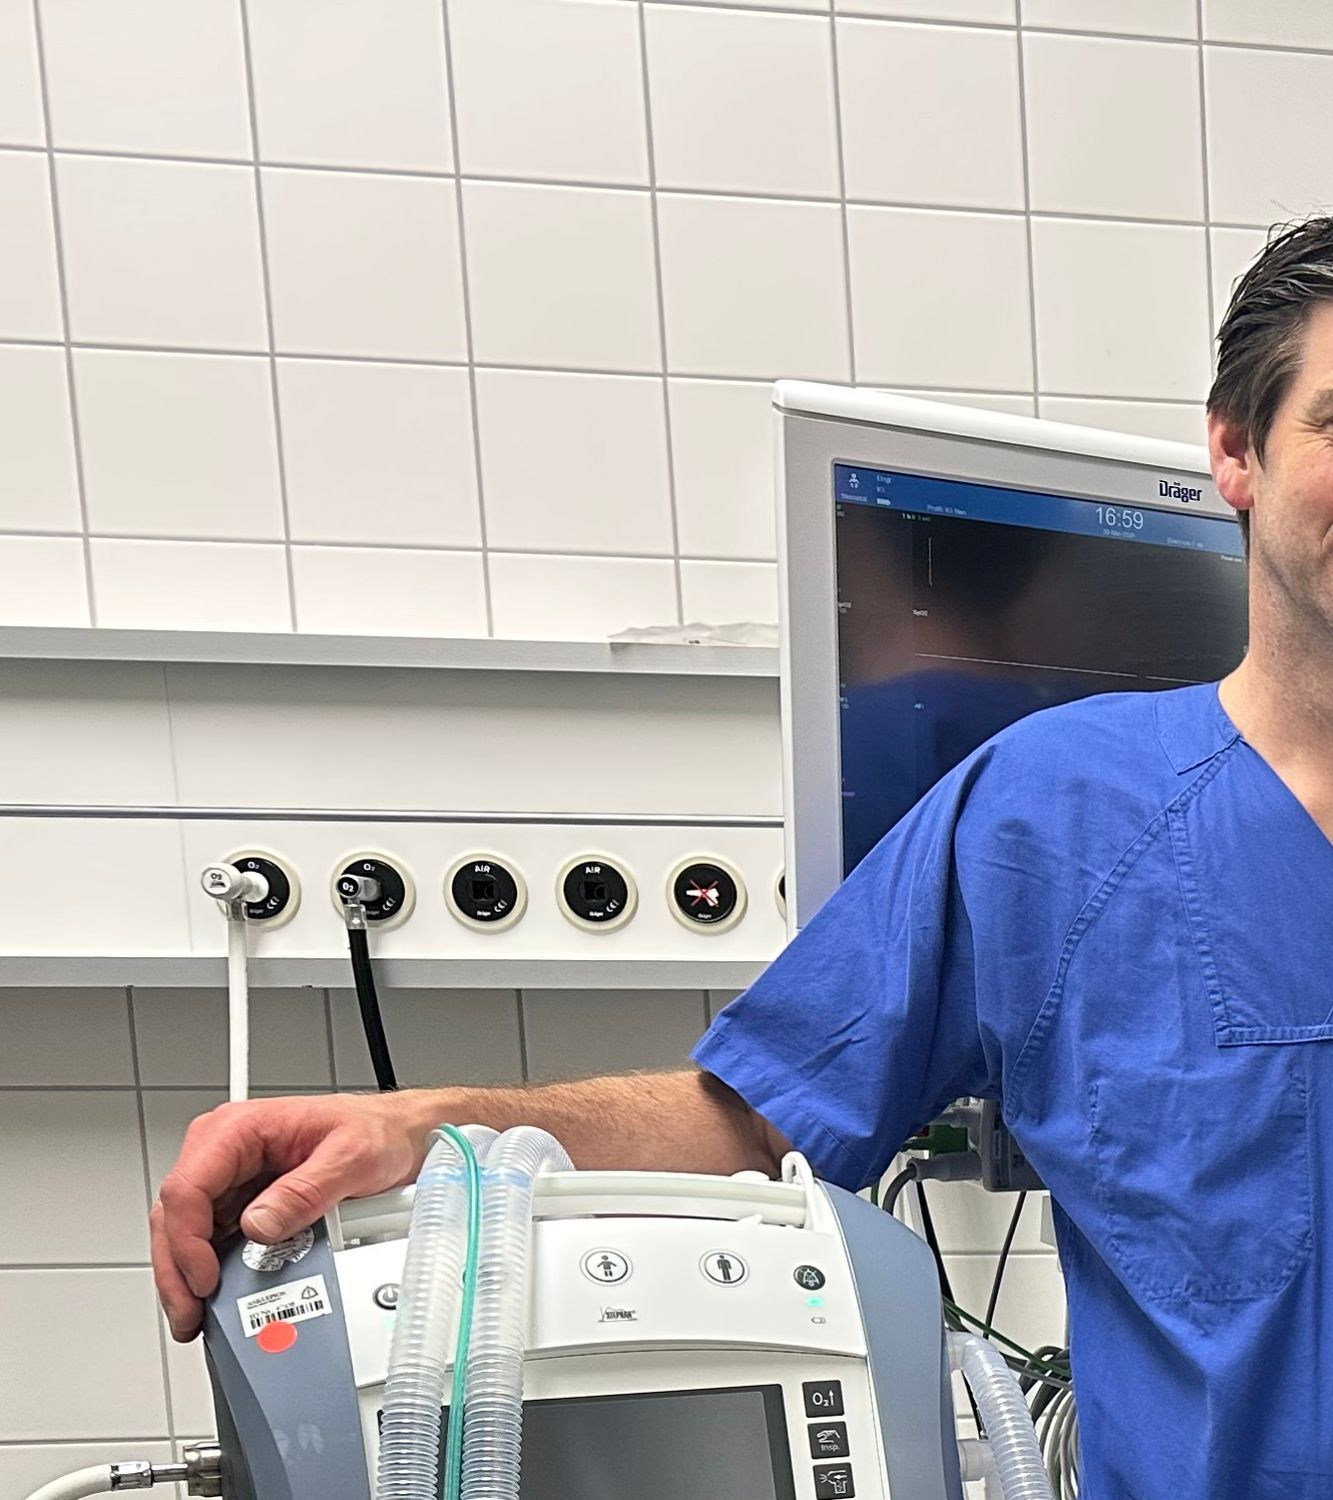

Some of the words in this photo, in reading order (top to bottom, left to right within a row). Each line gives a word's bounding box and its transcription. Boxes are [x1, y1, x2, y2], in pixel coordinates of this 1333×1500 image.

[1159, 480, 1203, 503] Dräger
[1095, 506, 1144, 530] 16:59
[474, 865, 491, 874] AIR
[585, 866, 601, 874] AIR
